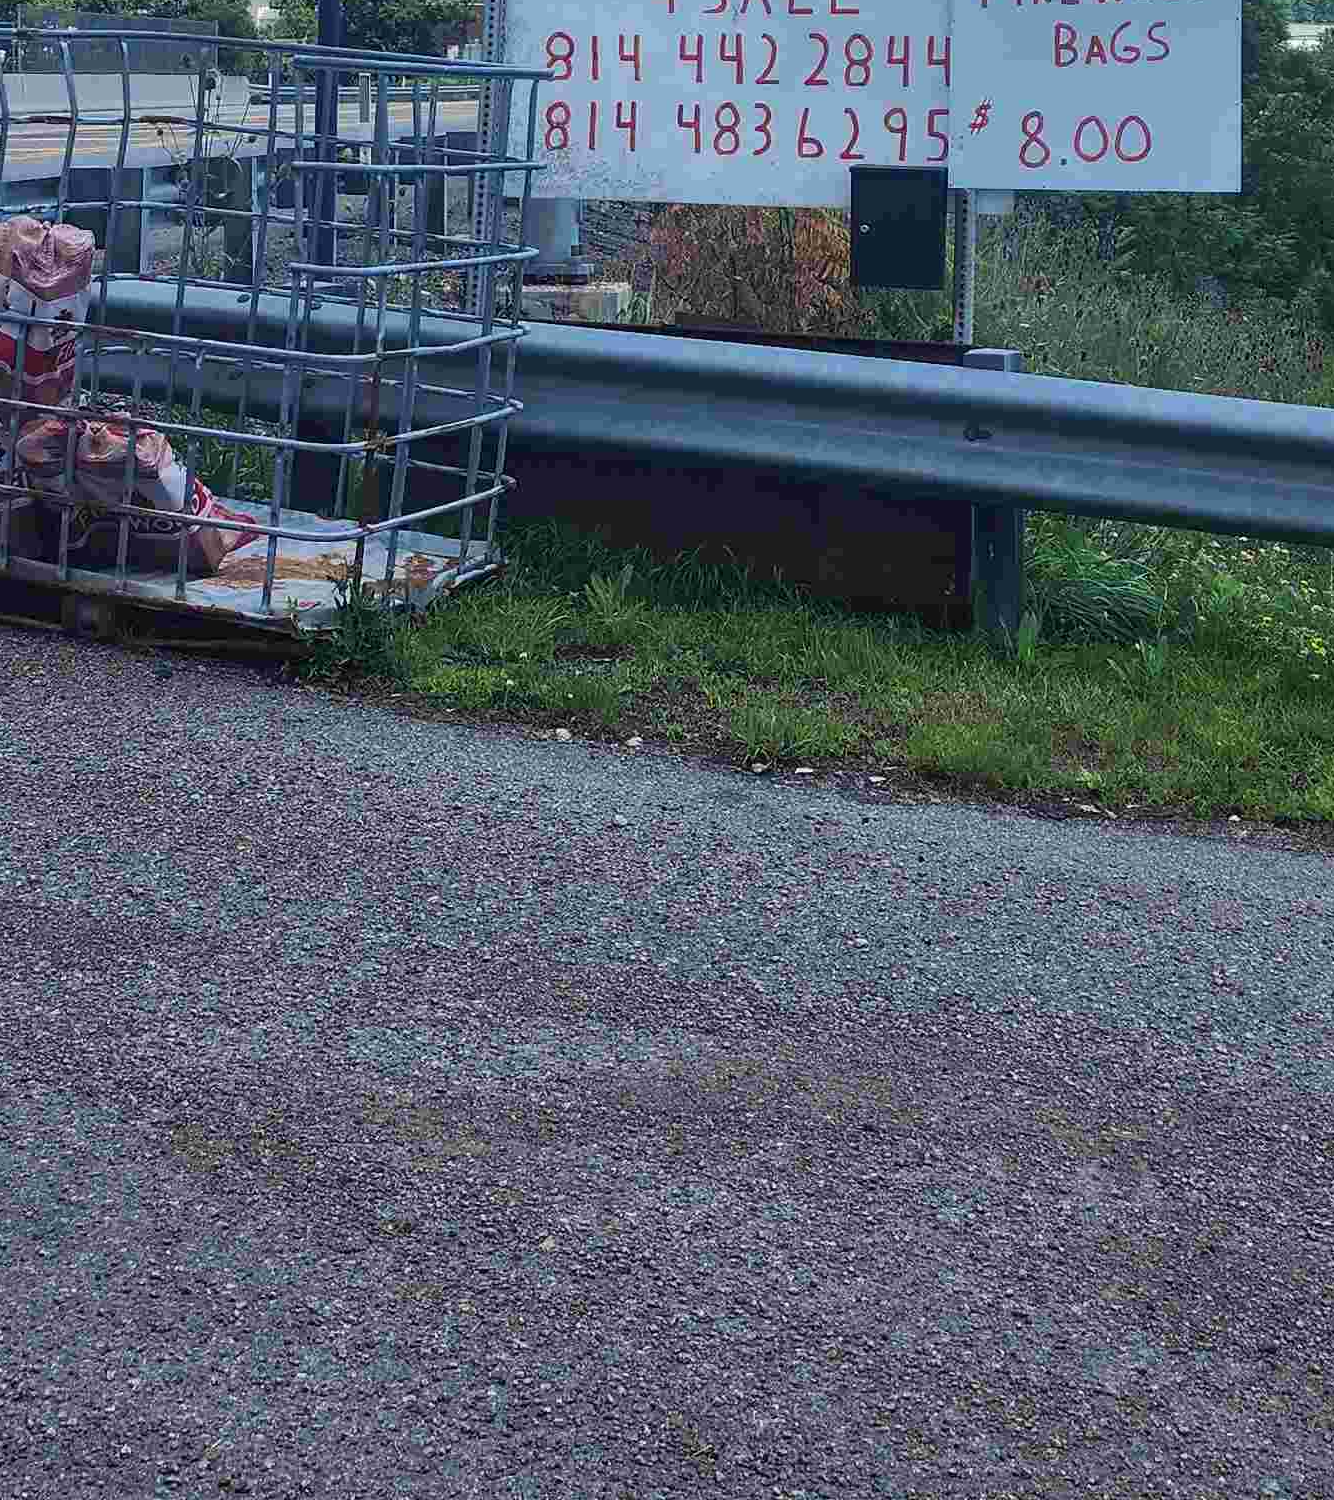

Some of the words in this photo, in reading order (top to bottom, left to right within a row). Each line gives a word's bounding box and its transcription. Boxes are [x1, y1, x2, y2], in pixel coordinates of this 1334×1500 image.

[545, 31, 643, 82] 814
[678, 32, 781, 86] 442
[544, 100, 637, 153] 814
[676, 101, 772, 157] 483
